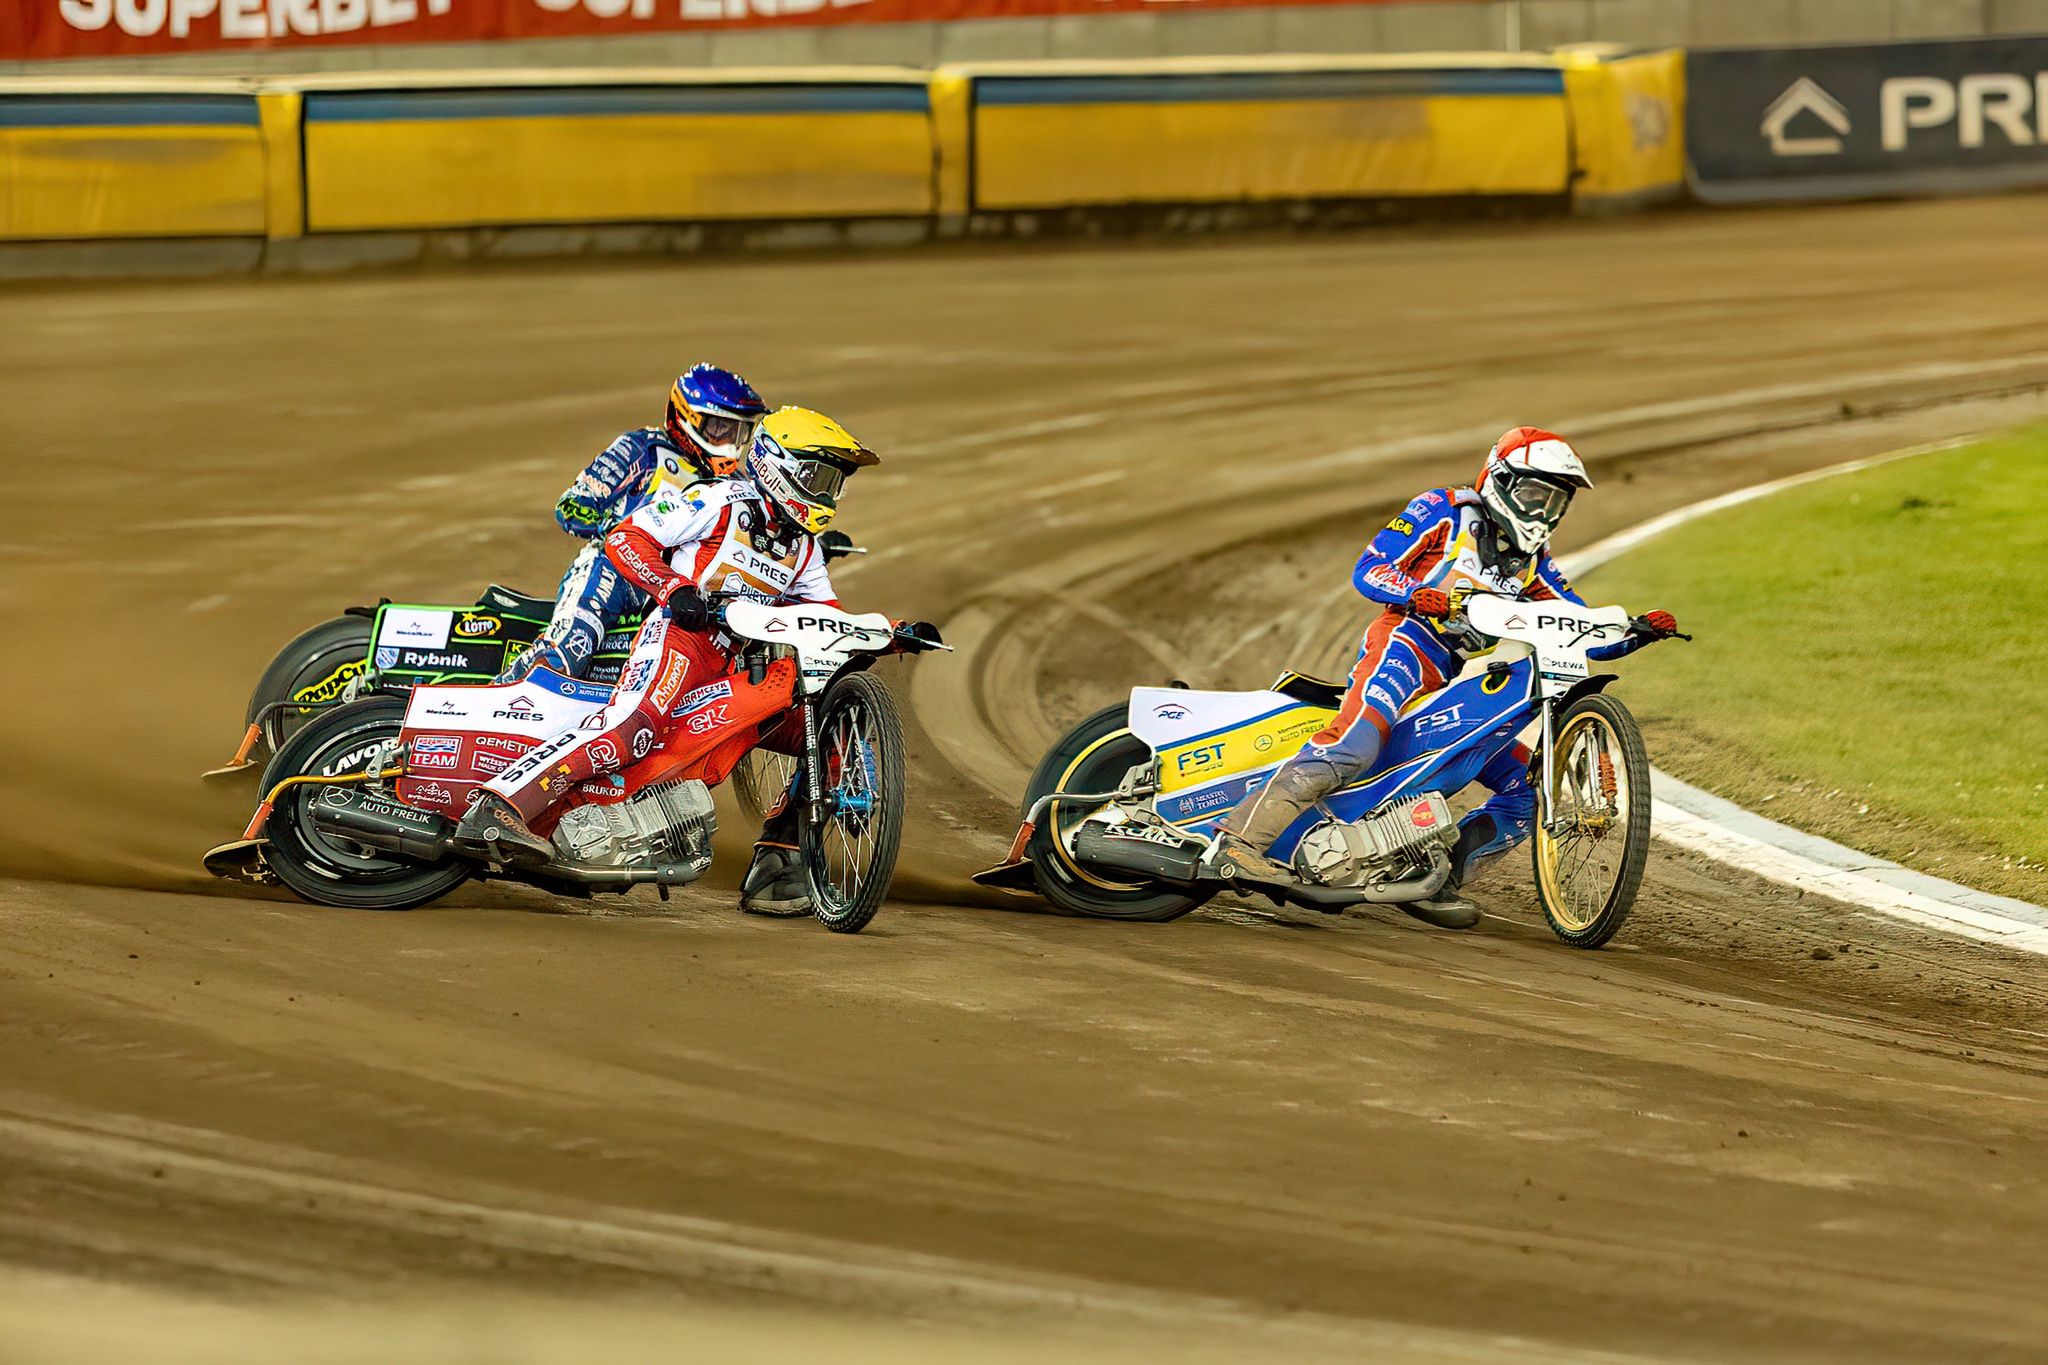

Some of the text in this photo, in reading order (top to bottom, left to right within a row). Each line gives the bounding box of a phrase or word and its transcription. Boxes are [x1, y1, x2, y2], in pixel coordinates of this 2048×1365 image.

[59, 0, 452, 38] SUPERB
[749, 556, 789, 586] PRES
[1480, 564, 1519, 596] PRES
[797, 616, 871, 642] PRES
[1537, 615, 1606, 640] PRES
[404, 651, 469, 668] Rybnik
[814, 659, 841, 667] PLEW
[492, 709, 545, 722] PRES
[1158, 710, 1185, 720] PGE
[1414, 702, 1465, 732] FST
[413, 753, 456, 767] TEAM
[502, 733, 576, 783] PRES
[1177, 742, 1227, 771] FST
[582, 783, 625, 797] BRUKOP
[358, 801, 432, 824] AUTO FRELIK
